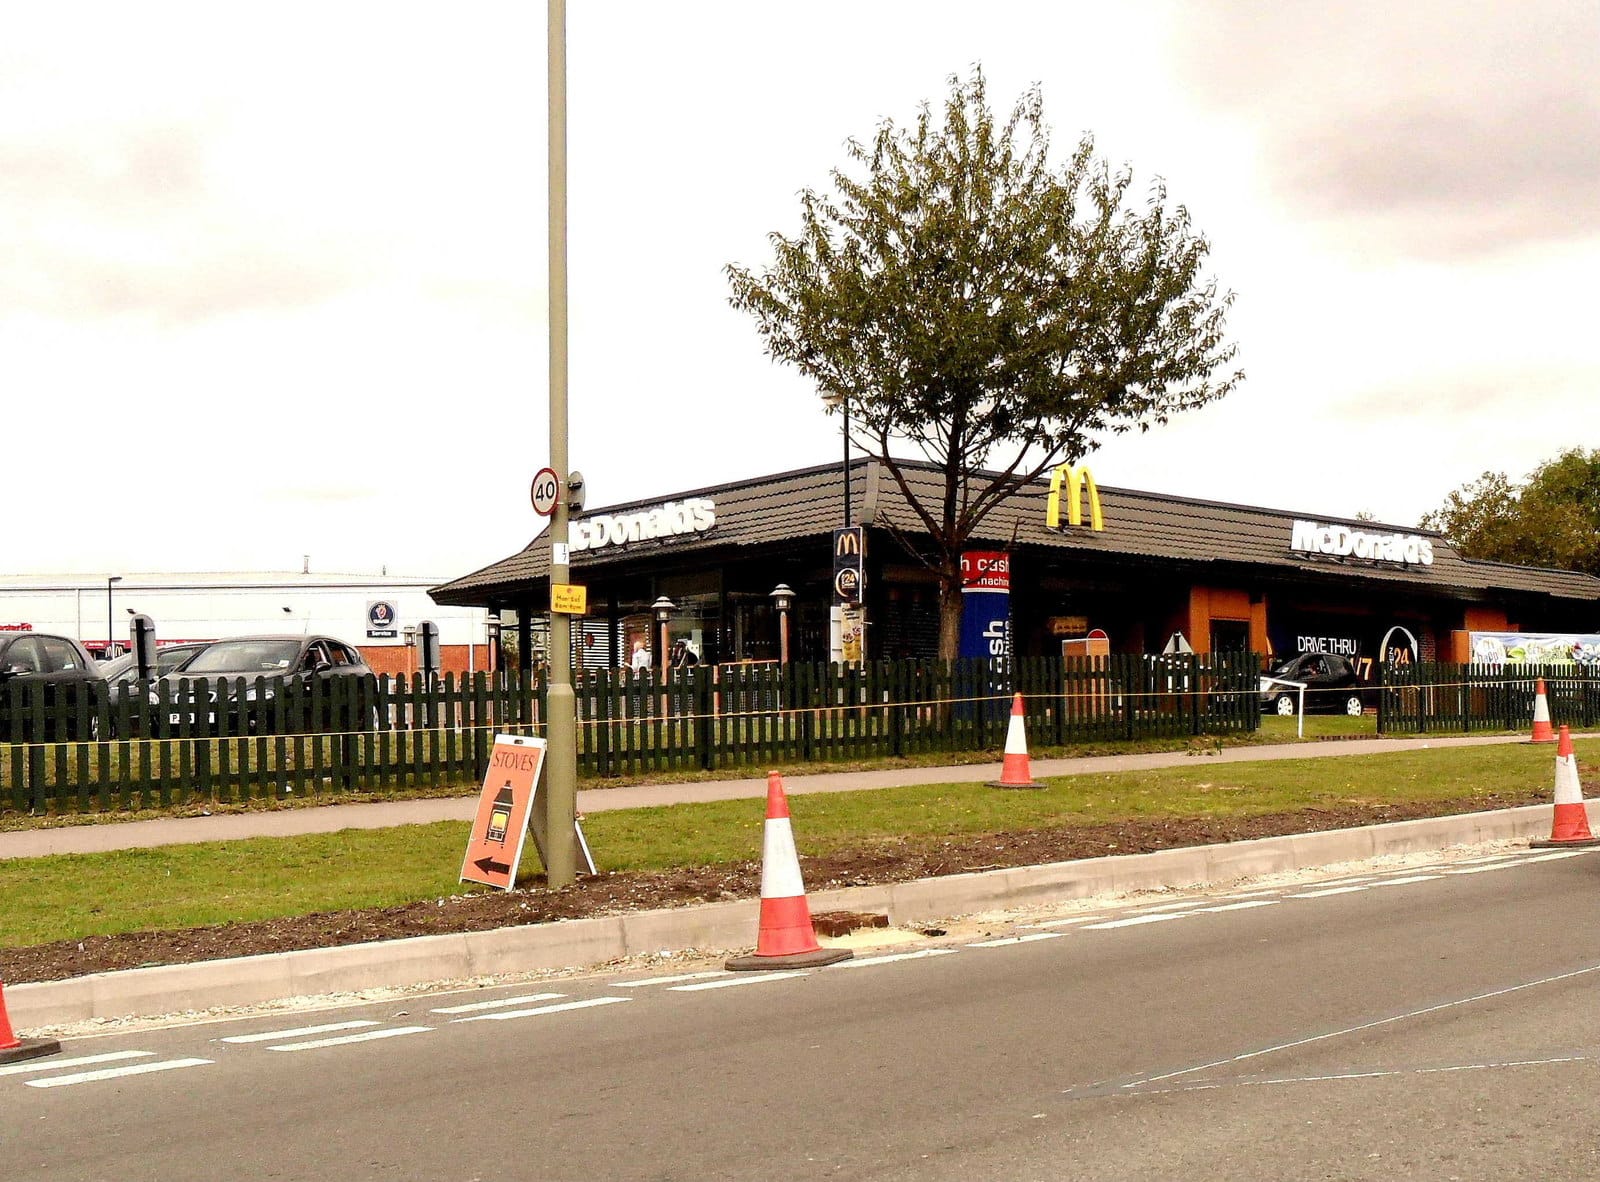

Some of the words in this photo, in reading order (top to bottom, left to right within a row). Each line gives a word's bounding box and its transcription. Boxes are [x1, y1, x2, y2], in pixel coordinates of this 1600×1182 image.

[535, 481, 556, 501] 40
[1291, 520, 1434, 565] McDonald's
[1297, 635, 1327, 654] DRIVE
[1328, 637, 1357, 655] THRU
[493, 751, 536, 771] STOVES
